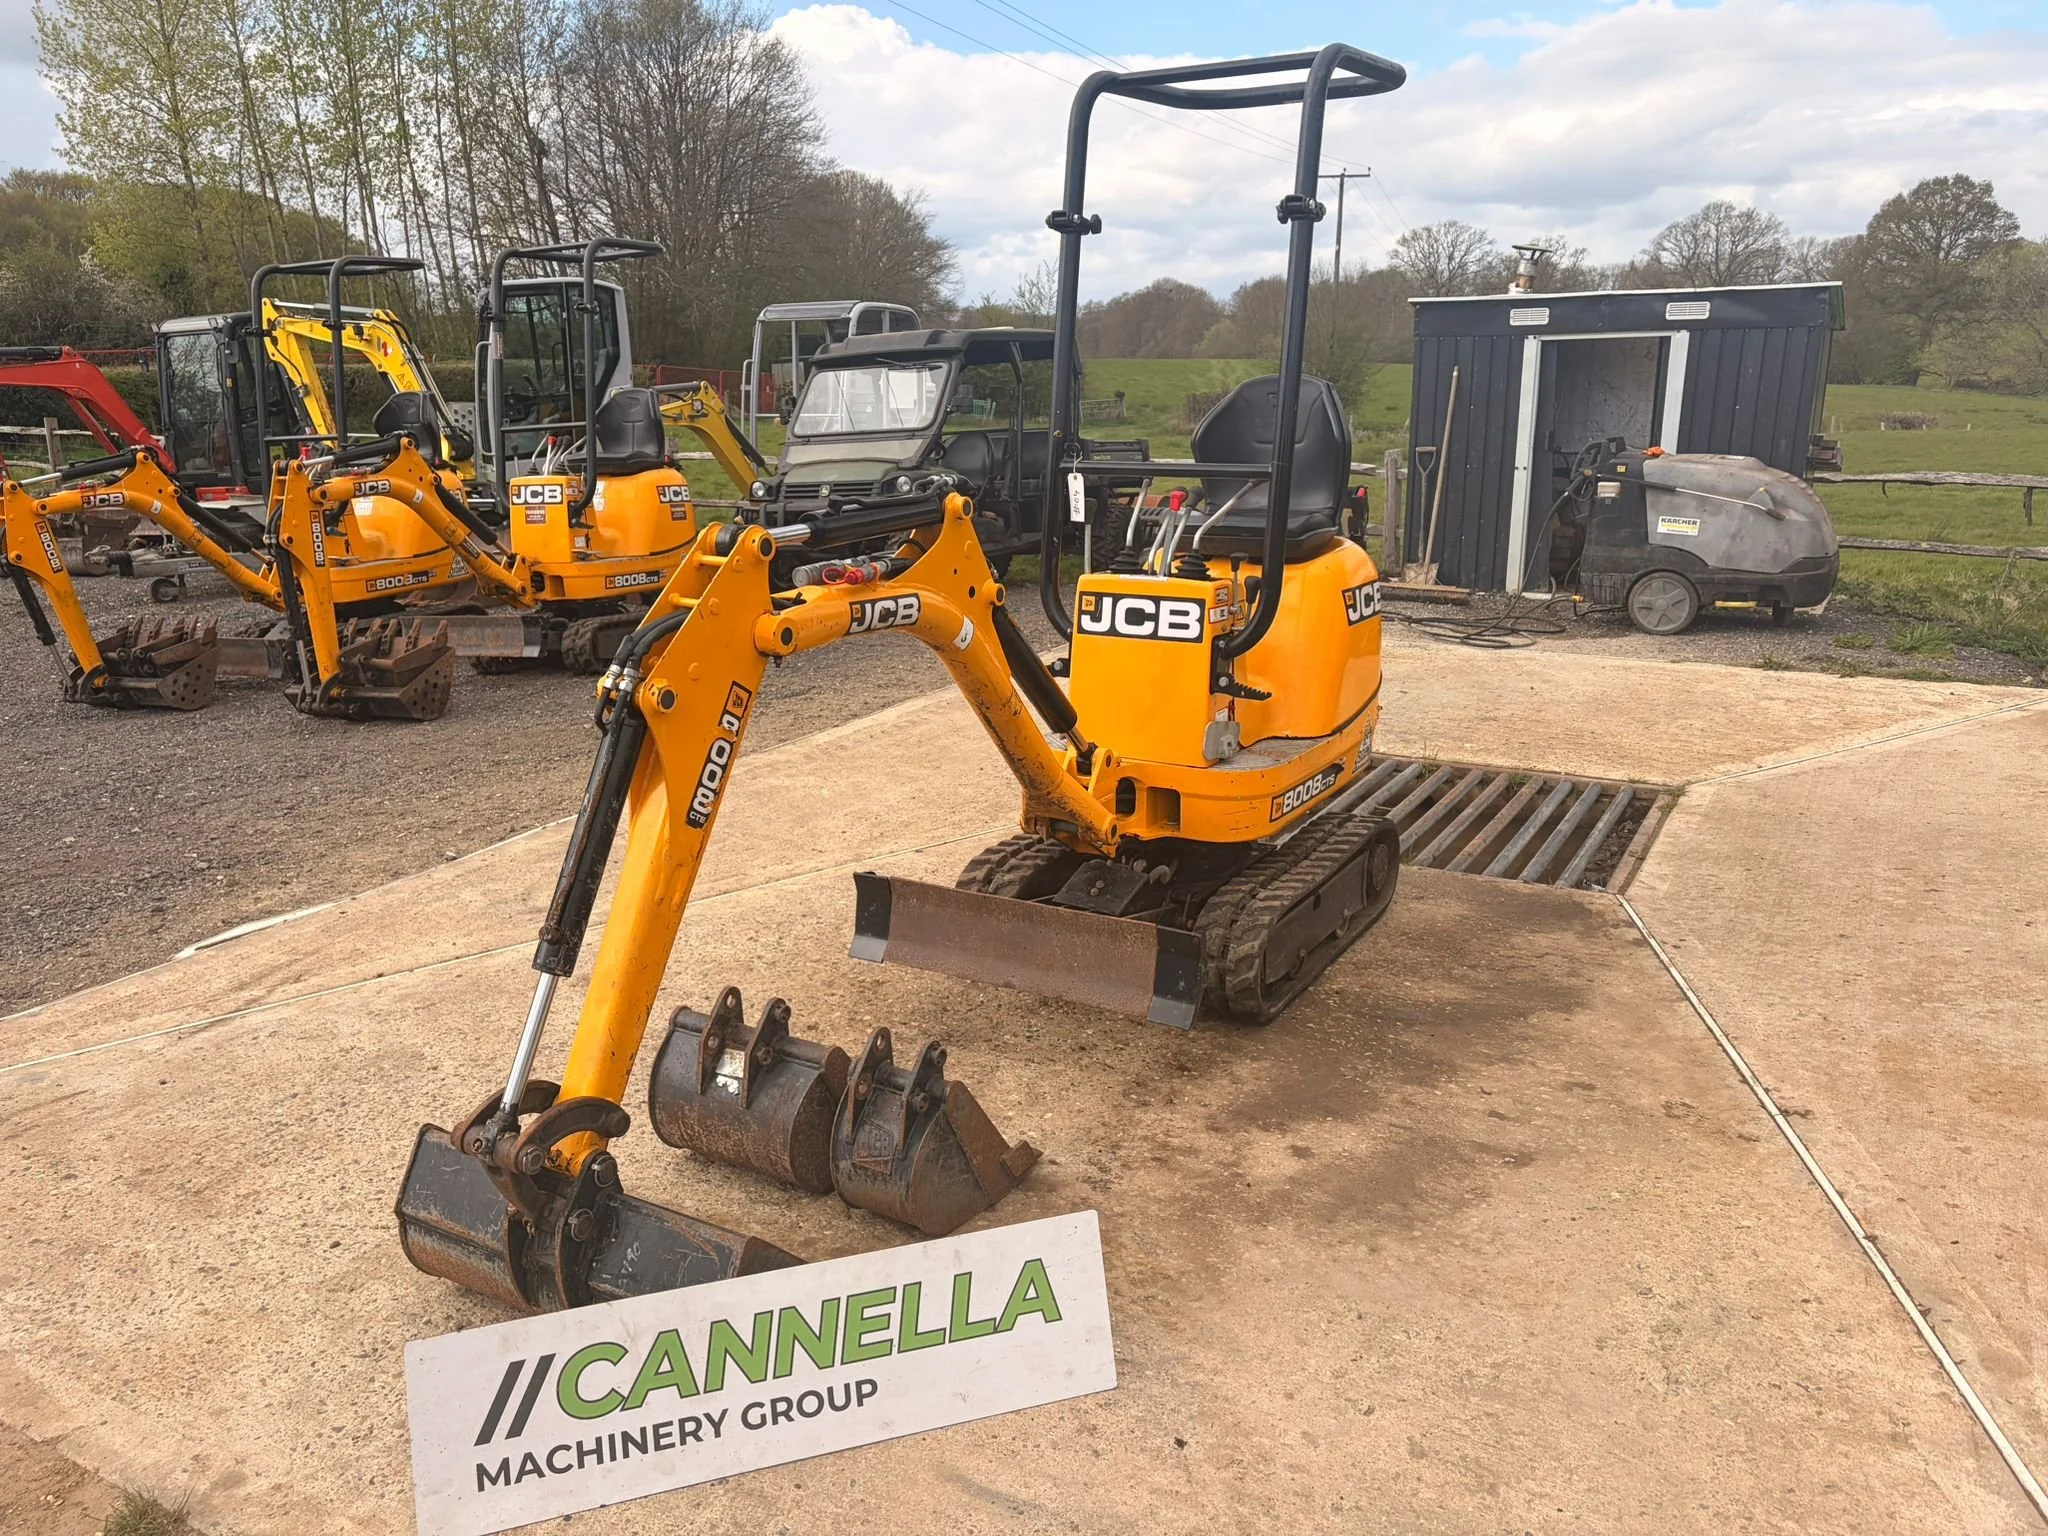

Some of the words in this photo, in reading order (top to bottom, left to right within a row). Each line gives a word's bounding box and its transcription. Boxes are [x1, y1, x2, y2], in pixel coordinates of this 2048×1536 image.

[83, 493, 124, 508] JCB
[355, 480, 390, 496] JCB
[512, 485, 562, 504] JCB
[660, 486, 690, 502] JCB
[849, 596, 919, 634] JCB
[1081, 596, 1200, 639] JCB
[1348, 581, 1381, 621] JCB
[556, 1258, 1063, 1420] CANNELLA
[475, 1407, 730, 1492] MACHINERY
[741, 1378, 879, 1430] GROUP
